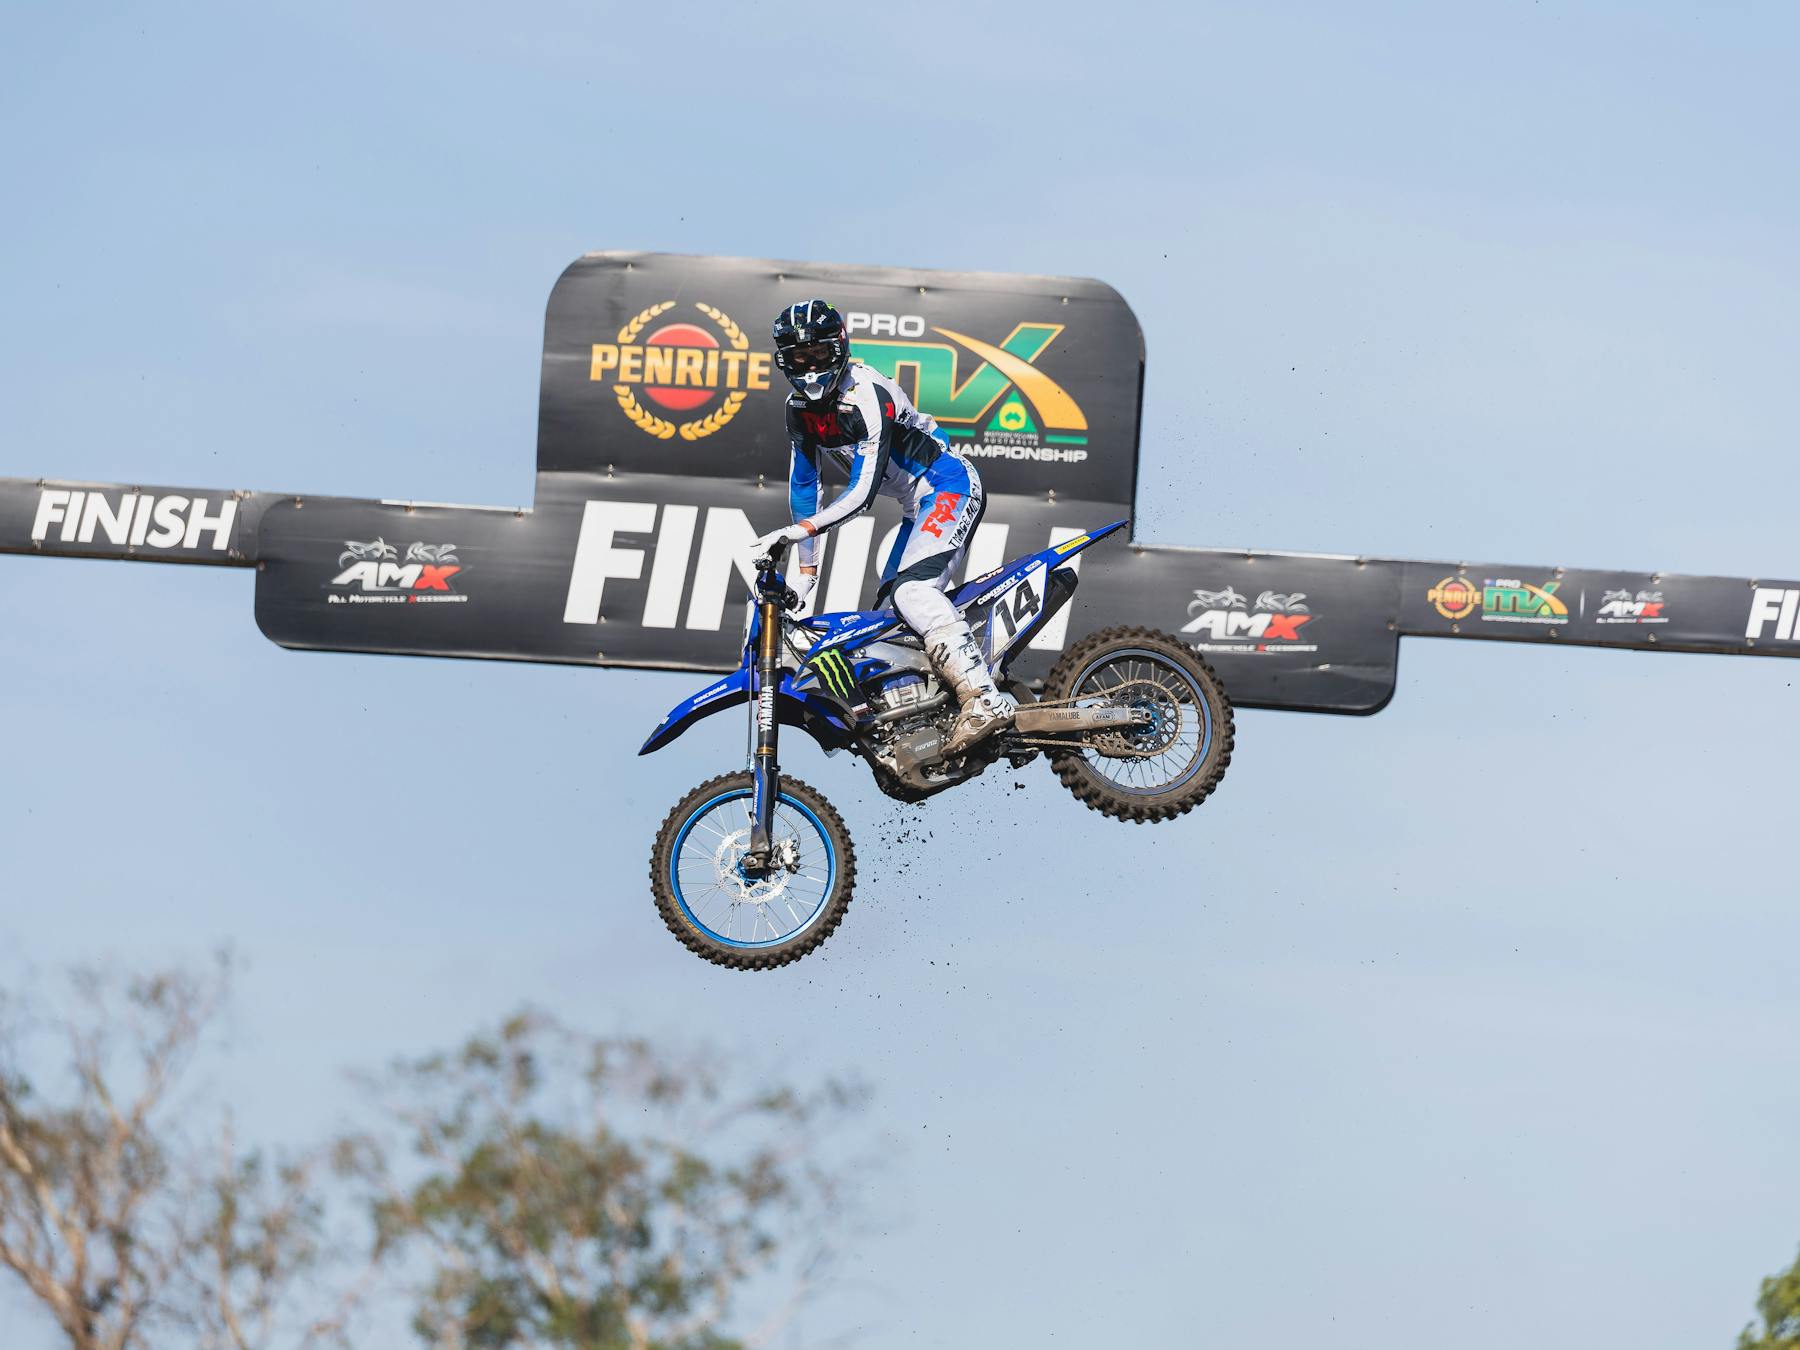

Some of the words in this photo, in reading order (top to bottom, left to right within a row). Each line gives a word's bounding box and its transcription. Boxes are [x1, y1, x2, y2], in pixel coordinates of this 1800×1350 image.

[847, 312, 925, 337] PRO
[590, 343, 772, 390] PENRITE
[31, 490, 238, 551] FINISH
[921, 491, 961, 538] FOX
[331, 560, 462, 592] AMX
[563, 500, 1087, 651] FINIH
[977, 575, 1018, 605] COMISKEY
[1495, 579, 1521, 589] PRO
[995, 579, 1041, 640] 14
[1598, 600, 1665, 617] AMX
[1180, 610, 1312, 640] AMX
[760, 685, 774, 732] YAMAHA
[1048, 711, 1080, 721] YAMALUBE
